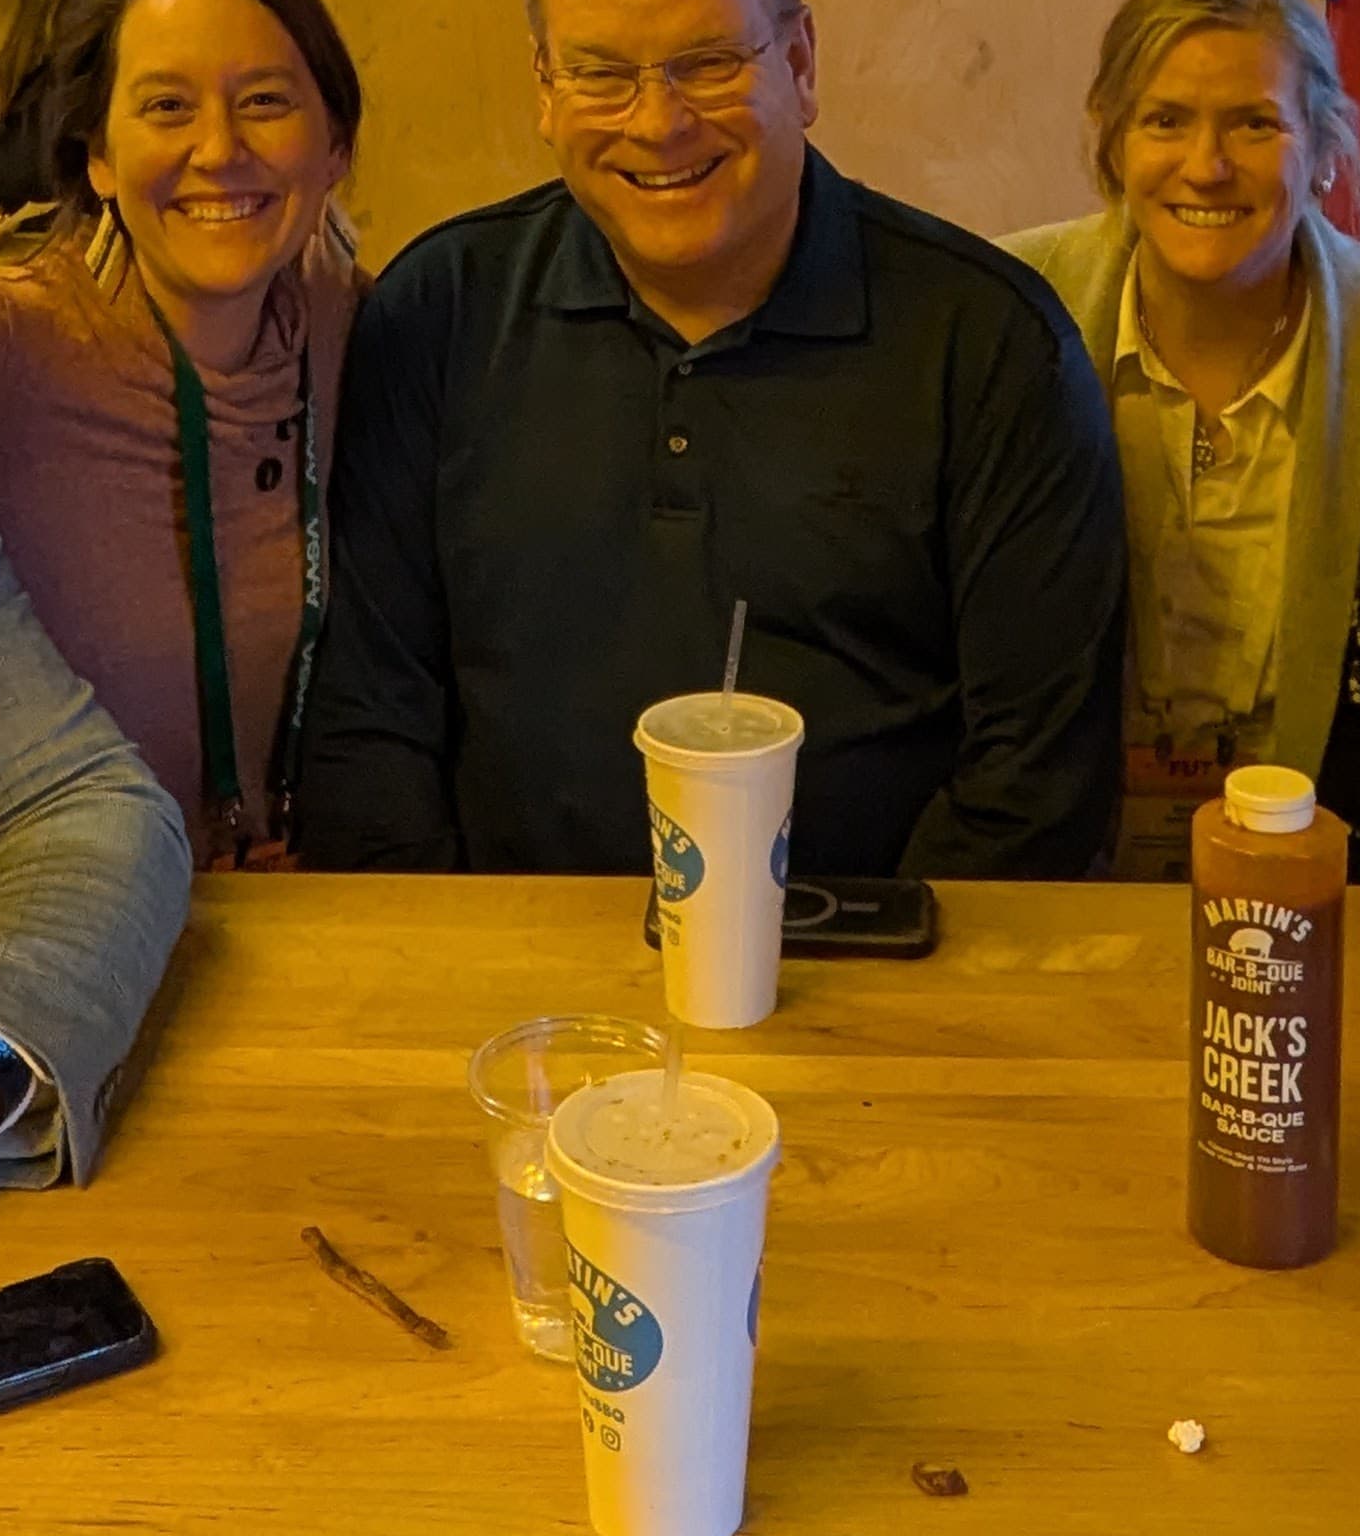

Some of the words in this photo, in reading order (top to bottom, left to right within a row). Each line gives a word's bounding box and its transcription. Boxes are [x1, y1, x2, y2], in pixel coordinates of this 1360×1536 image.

[1203, 897, 1313, 943] MARTIN'S
[1206, 946, 1304, 982] BAR-B-QUE
[1231, 975, 1273, 996] JOINT
[1202, 1000, 1308, 1058] JACK'S
[1203, 1045, 1304, 1105] CREEK
[1201, 1091, 1305, 1128] BAR-B-QUE
[1216, 1117, 1286, 1144] SAUCE
